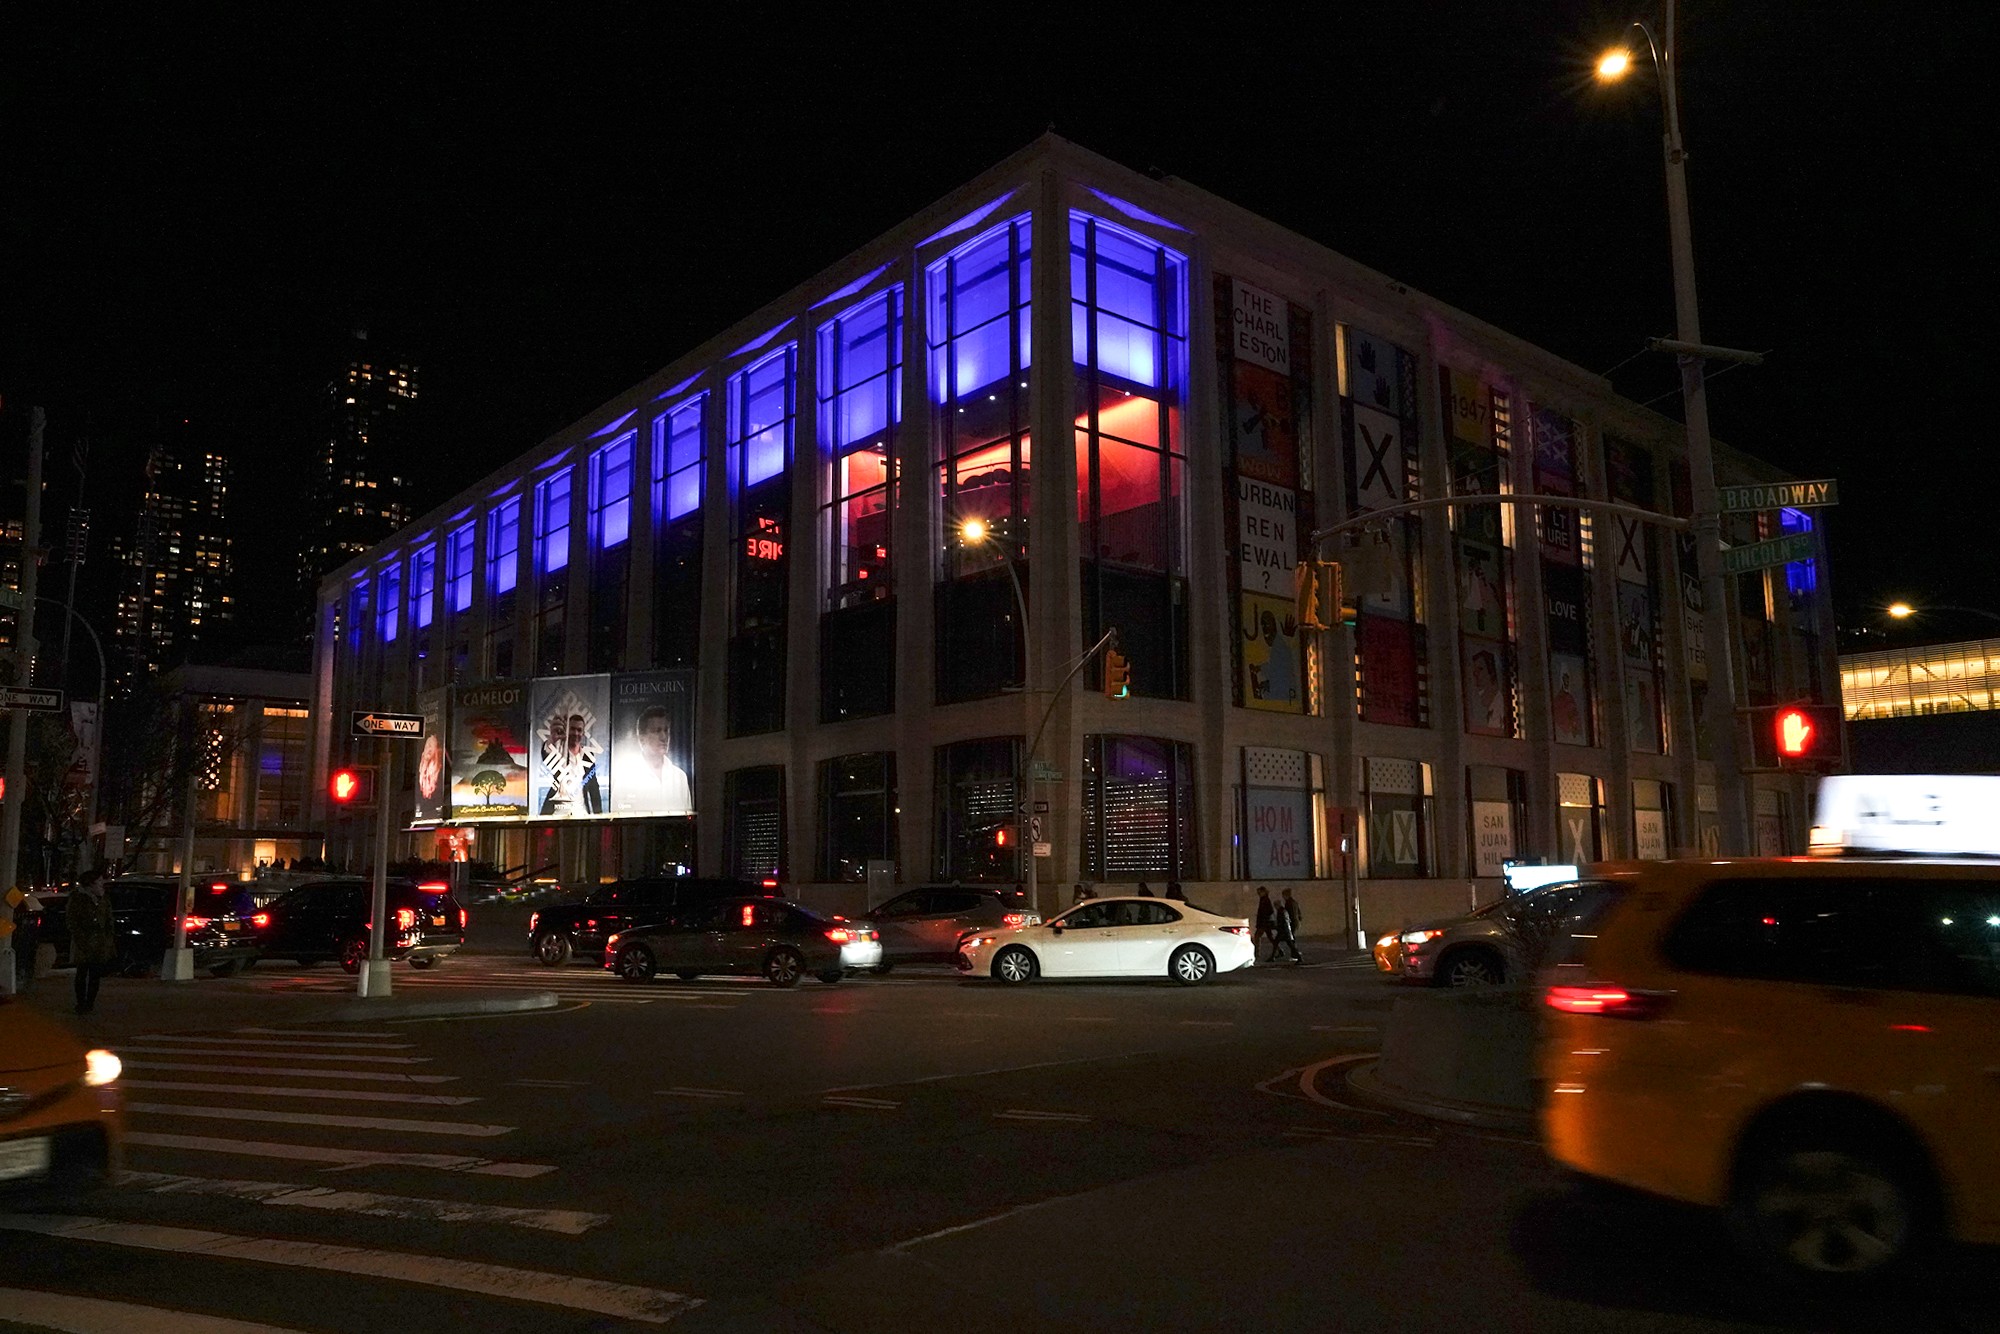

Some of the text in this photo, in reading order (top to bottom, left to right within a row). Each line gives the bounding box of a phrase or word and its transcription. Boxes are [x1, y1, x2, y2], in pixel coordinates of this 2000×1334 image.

[1241, 289, 1272, 316] THE
[1233, 307, 1284, 341] CHARL
[1239, 332, 1286, 364] ESTON
[1451, 394, 1487, 426] 1947
[1358, 423, 1398, 500] X
[1240, 483, 1295, 513] URBAN
[1727, 483, 1829, 509] BROADWAY
[1246, 515, 1285, 542] REN
[1241, 543, 1293, 571] EWAL
[1726, 540, 1791, 572] LINCOLN
[1261, 571, 1271, 590] ?
[1550, 600, 1577, 621] LOVE
[29, 695, 52, 704] WAY
[462, 688, 521, 707] CAMELOT
[619, 680, 685, 696] LOHENGRIN
[363, 719, 416, 731] ONE WAY
[1483, 814, 1504, 829] SAN
[1642, 822, 1658, 833] SAN
[1269, 838, 1301, 867] AGE
[1480, 833, 1508, 847] JUAN
[1640, 837, 1662, 850] JUAN
